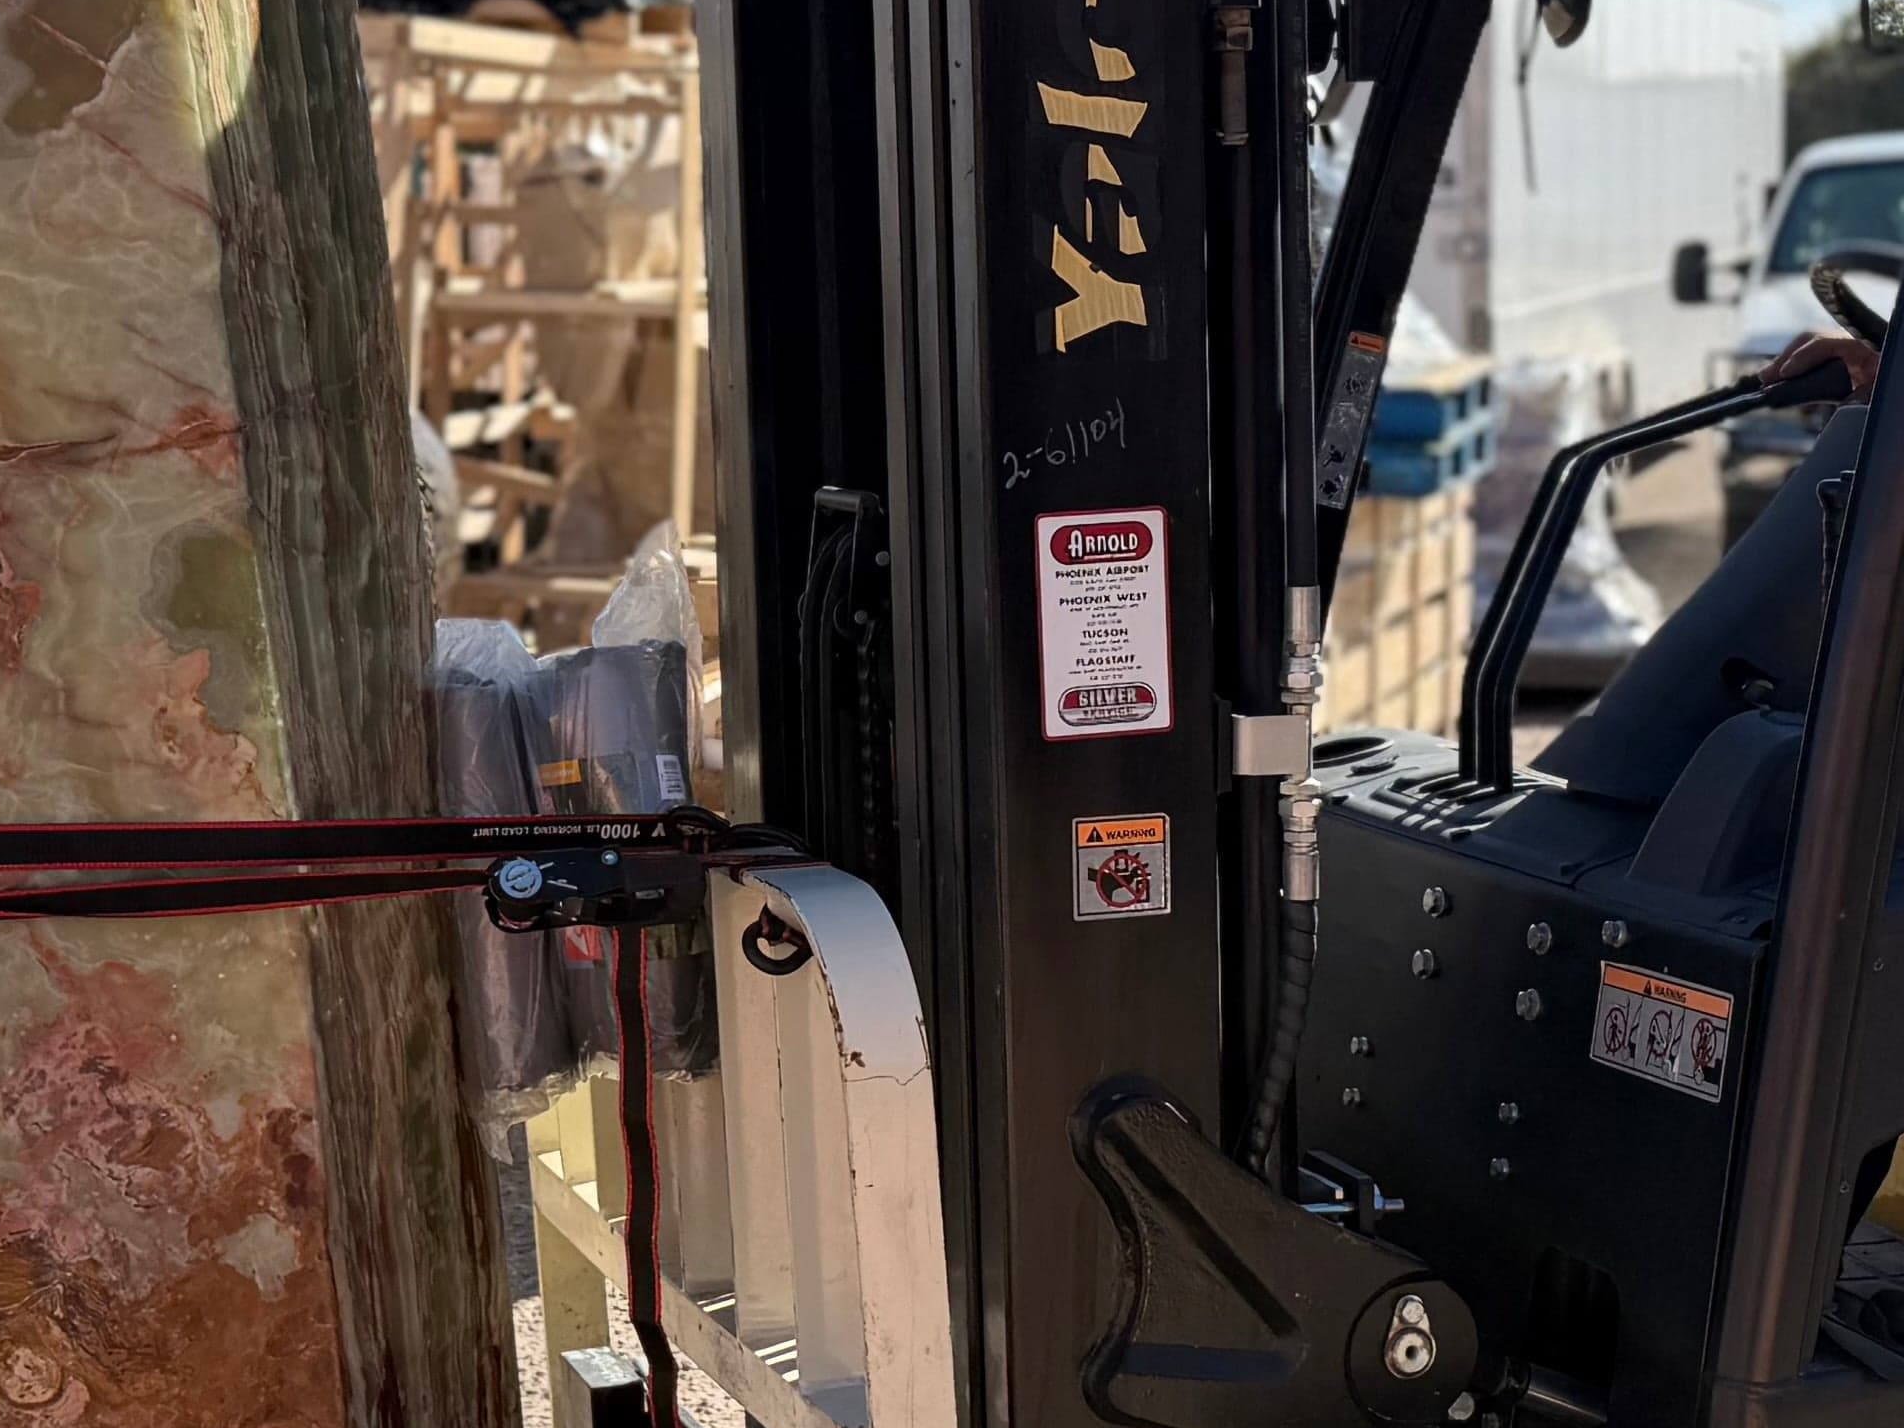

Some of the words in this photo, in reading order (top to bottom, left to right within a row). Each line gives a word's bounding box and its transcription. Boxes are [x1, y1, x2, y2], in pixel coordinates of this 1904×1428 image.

[1003, 396, 1126, 489] 2-61104
[1068, 530, 1138, 558] ARNOLD
[1056, 567, 1101, 579] PHOENIX
[1059, 595, 1111, 606] PHOENIX
[1117, 592, 1147, 602] WEST
[1082, 628, 1128, 639] TUCSON
[1076, 655, 1136, 667] FLAGSTAFF
[1079, 687, 1137, 707] SILVER
[472, 828, 501, 838] LIMIT
[501, 827, 529, 836] LOAD
[1106, 828, 1156, 840] WARNING
